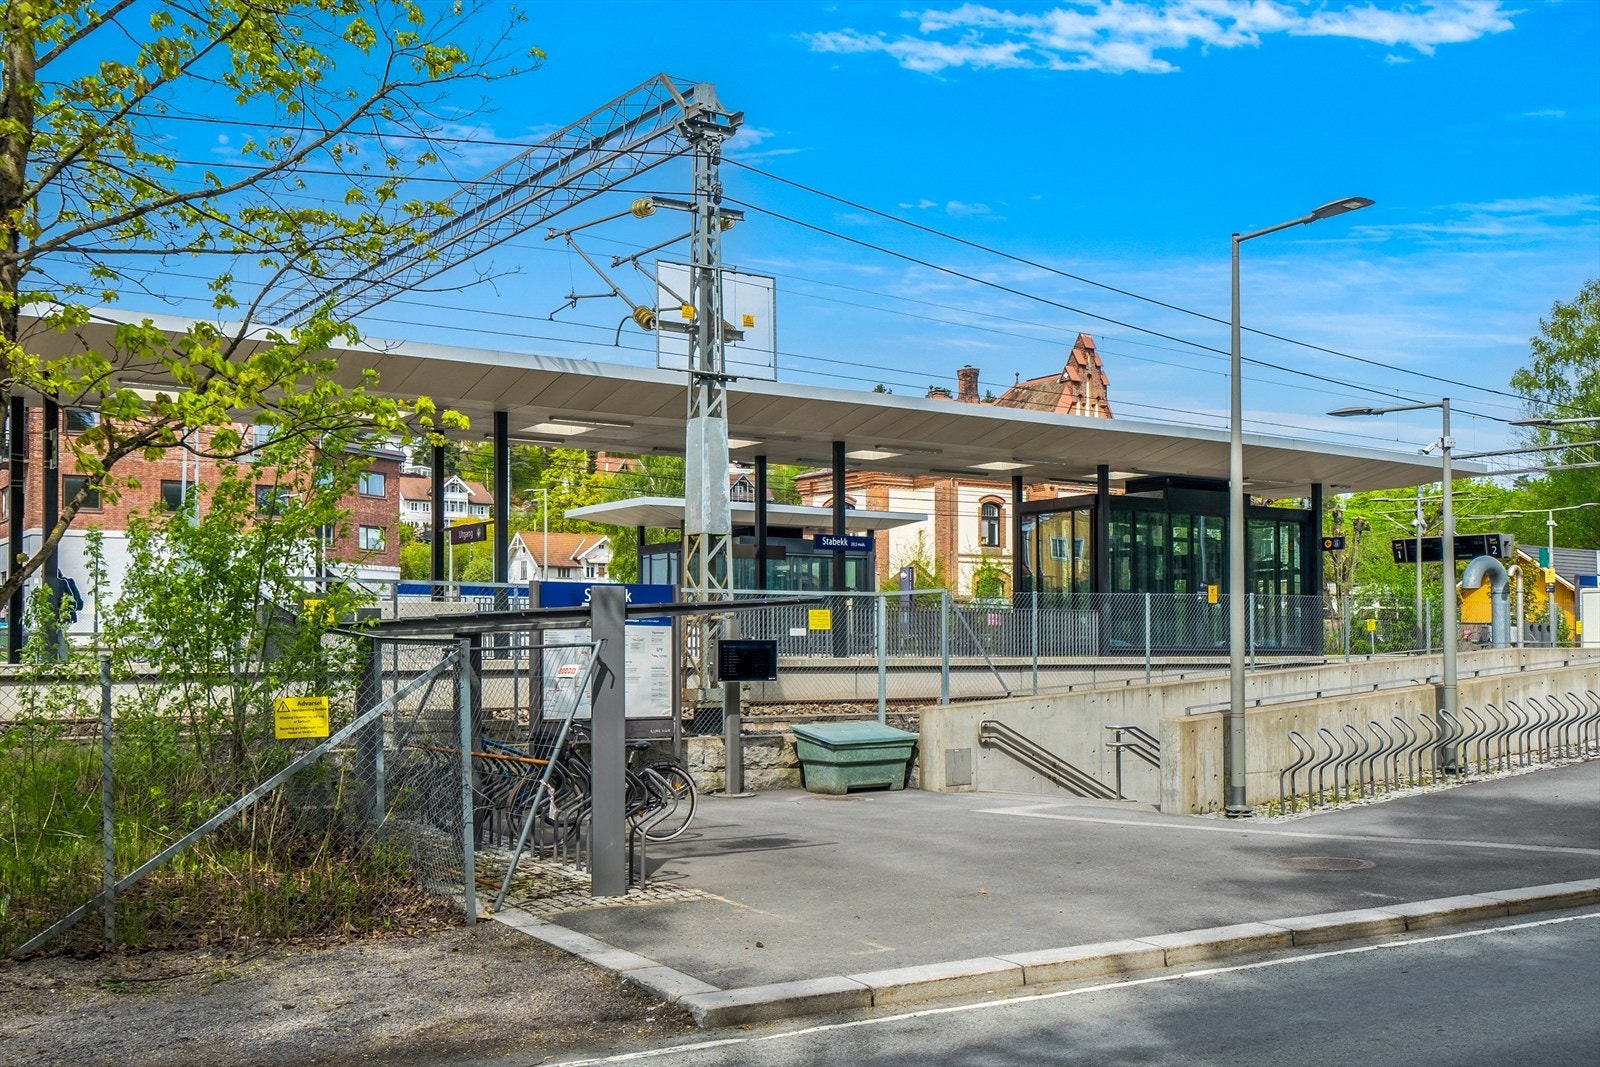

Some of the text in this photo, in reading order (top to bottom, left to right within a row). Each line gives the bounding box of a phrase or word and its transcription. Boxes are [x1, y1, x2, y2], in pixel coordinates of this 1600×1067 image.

[459, 530, 473, 540] Utgang
[822, 536, 848, 546] Stabekk
[1491, 546, 1498, 554] 2
[1397, 551, 1402, 559] 1
